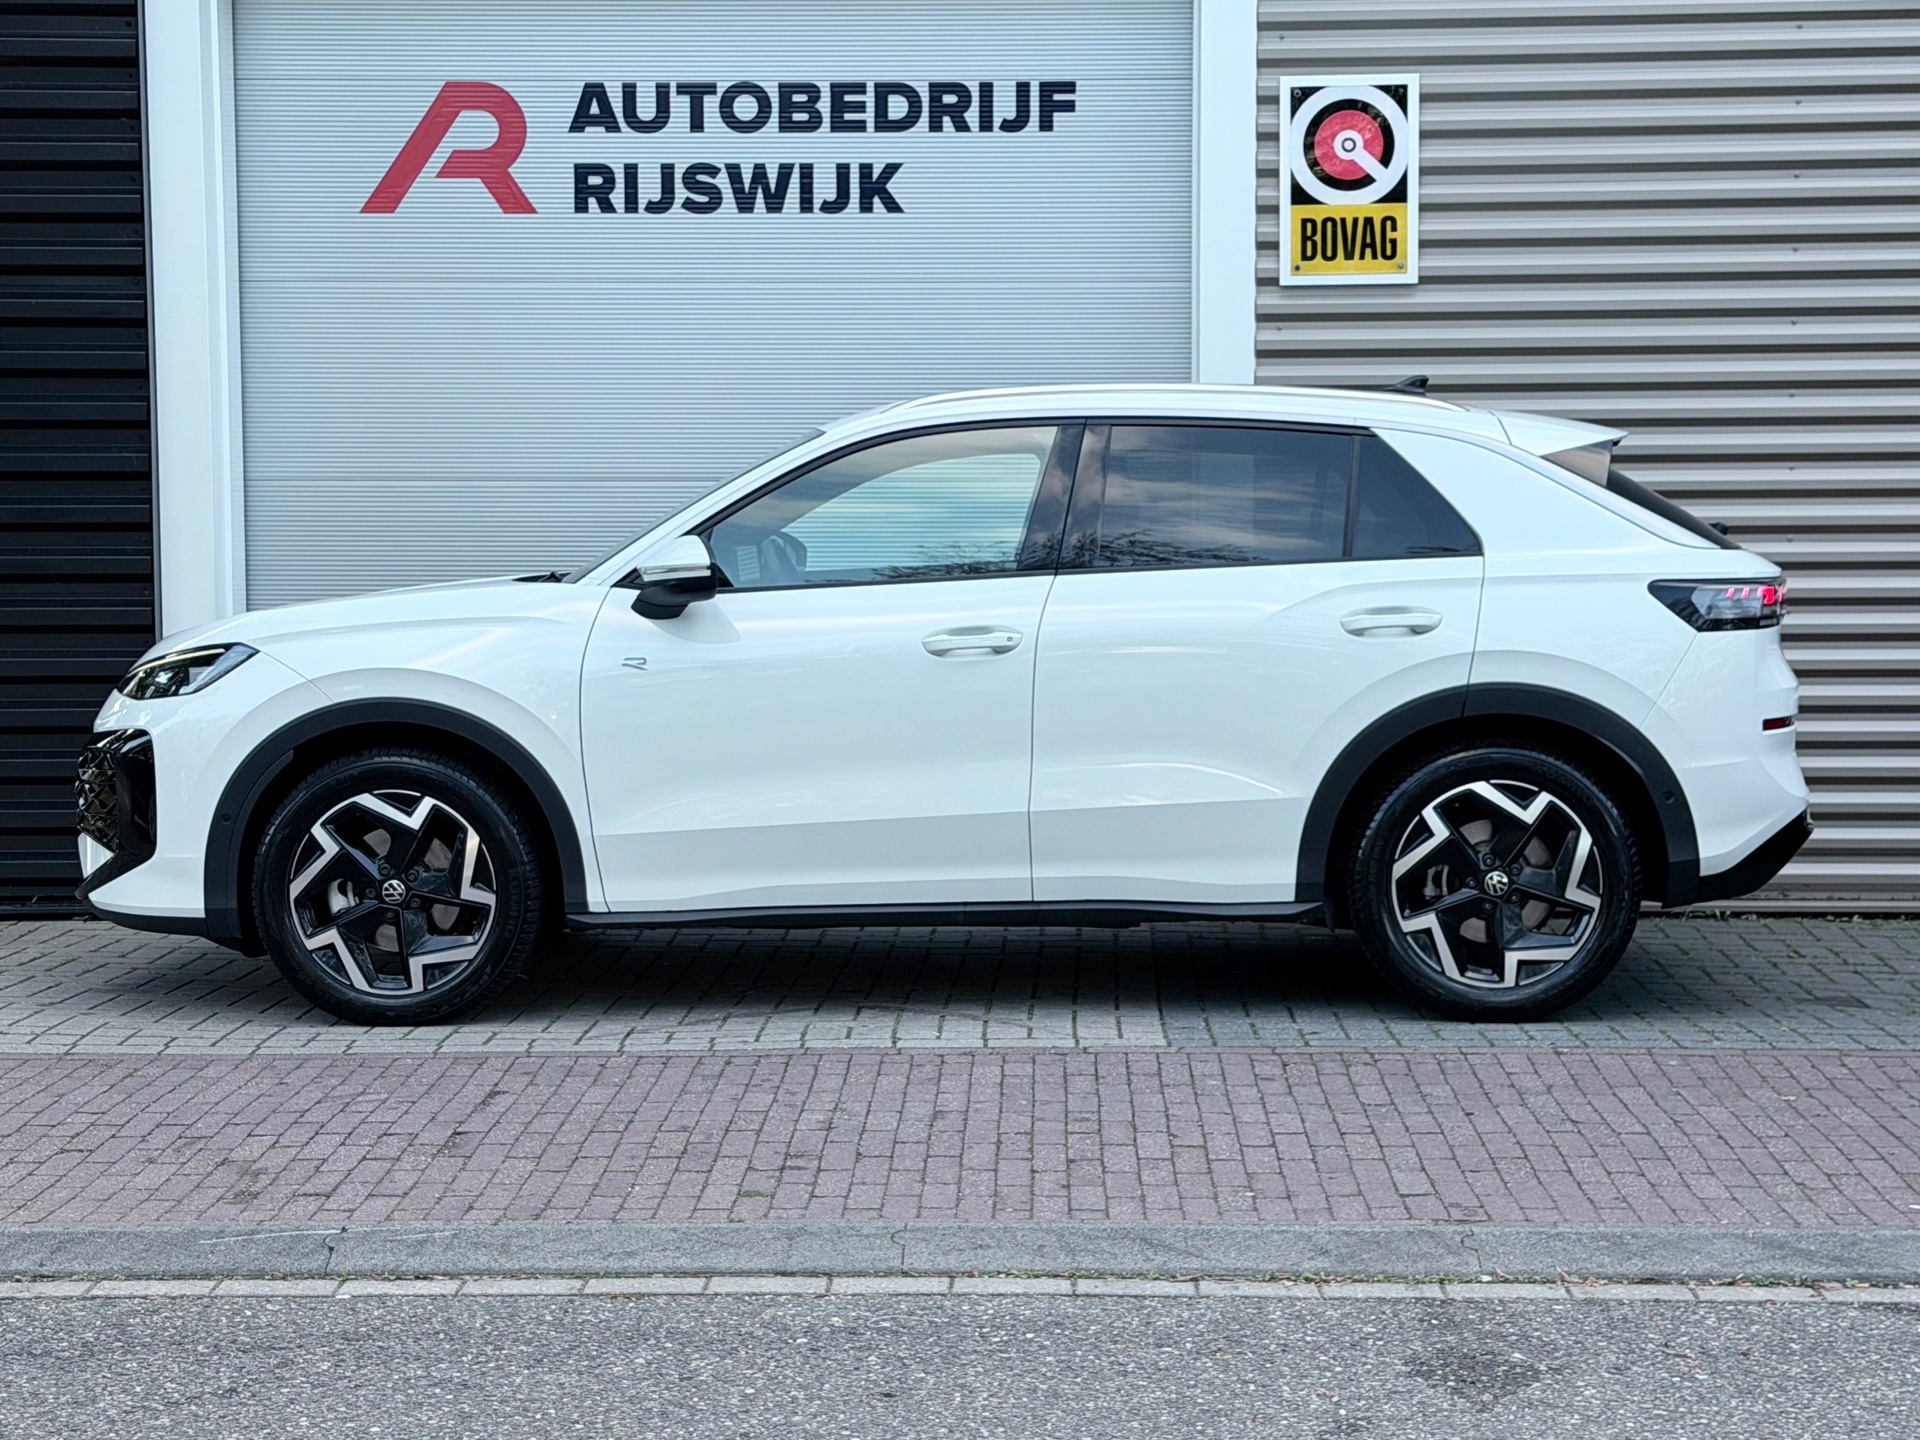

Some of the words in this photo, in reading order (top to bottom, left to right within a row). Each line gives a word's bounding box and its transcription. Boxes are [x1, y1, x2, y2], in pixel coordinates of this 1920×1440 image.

[568, 81, 1077, 134] AUTOBEDRIJF
[573, 162, 905, 214] RIJSWIJK
[1300, 215, 1398, 262] BOVAG
